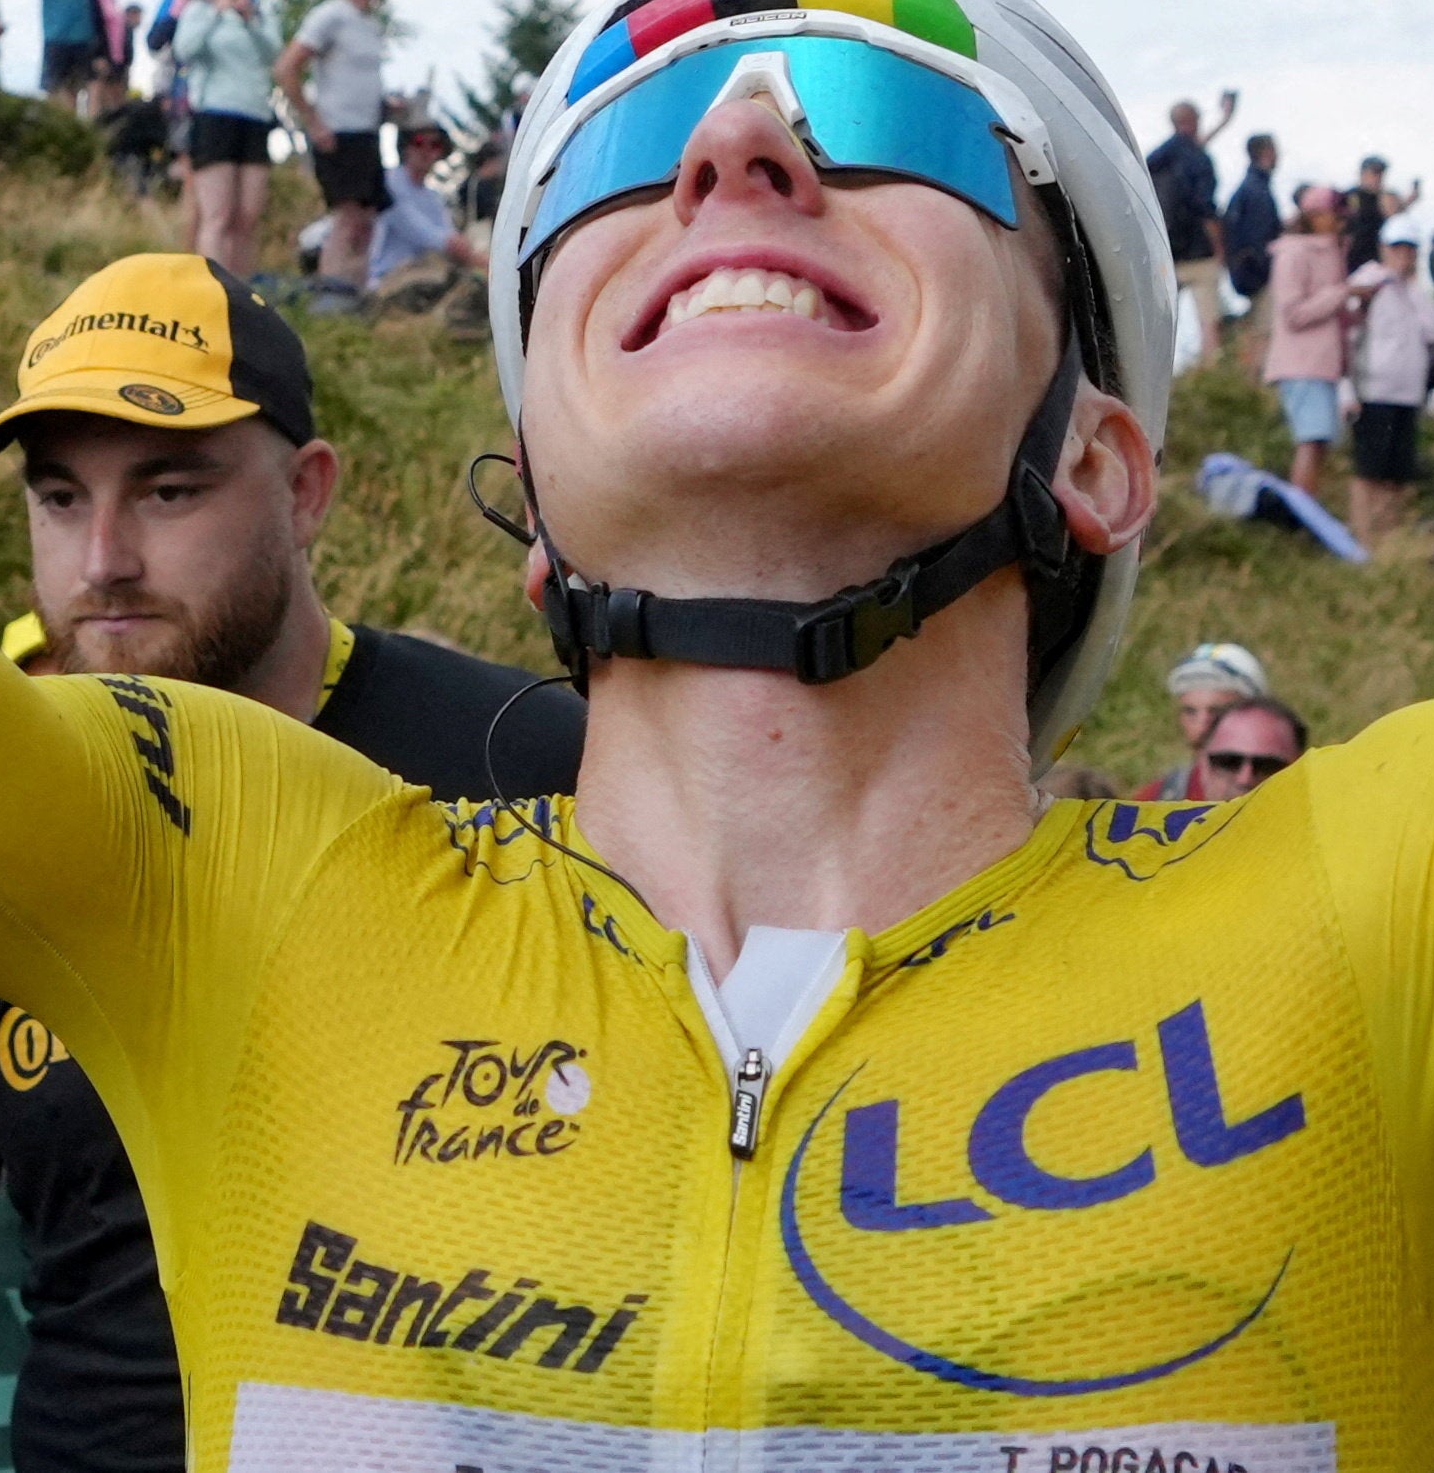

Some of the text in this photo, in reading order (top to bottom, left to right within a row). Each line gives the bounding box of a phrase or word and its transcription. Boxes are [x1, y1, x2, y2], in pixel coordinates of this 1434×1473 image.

[513, 1090, 540, 1117] de
[732, 1092, 754, 1147] Santini
[840, 998, 1306, 1232] LCL
[276, 1219, 650, 1374] Santini
[1050, 1446, 1249, 1473] POGAC
